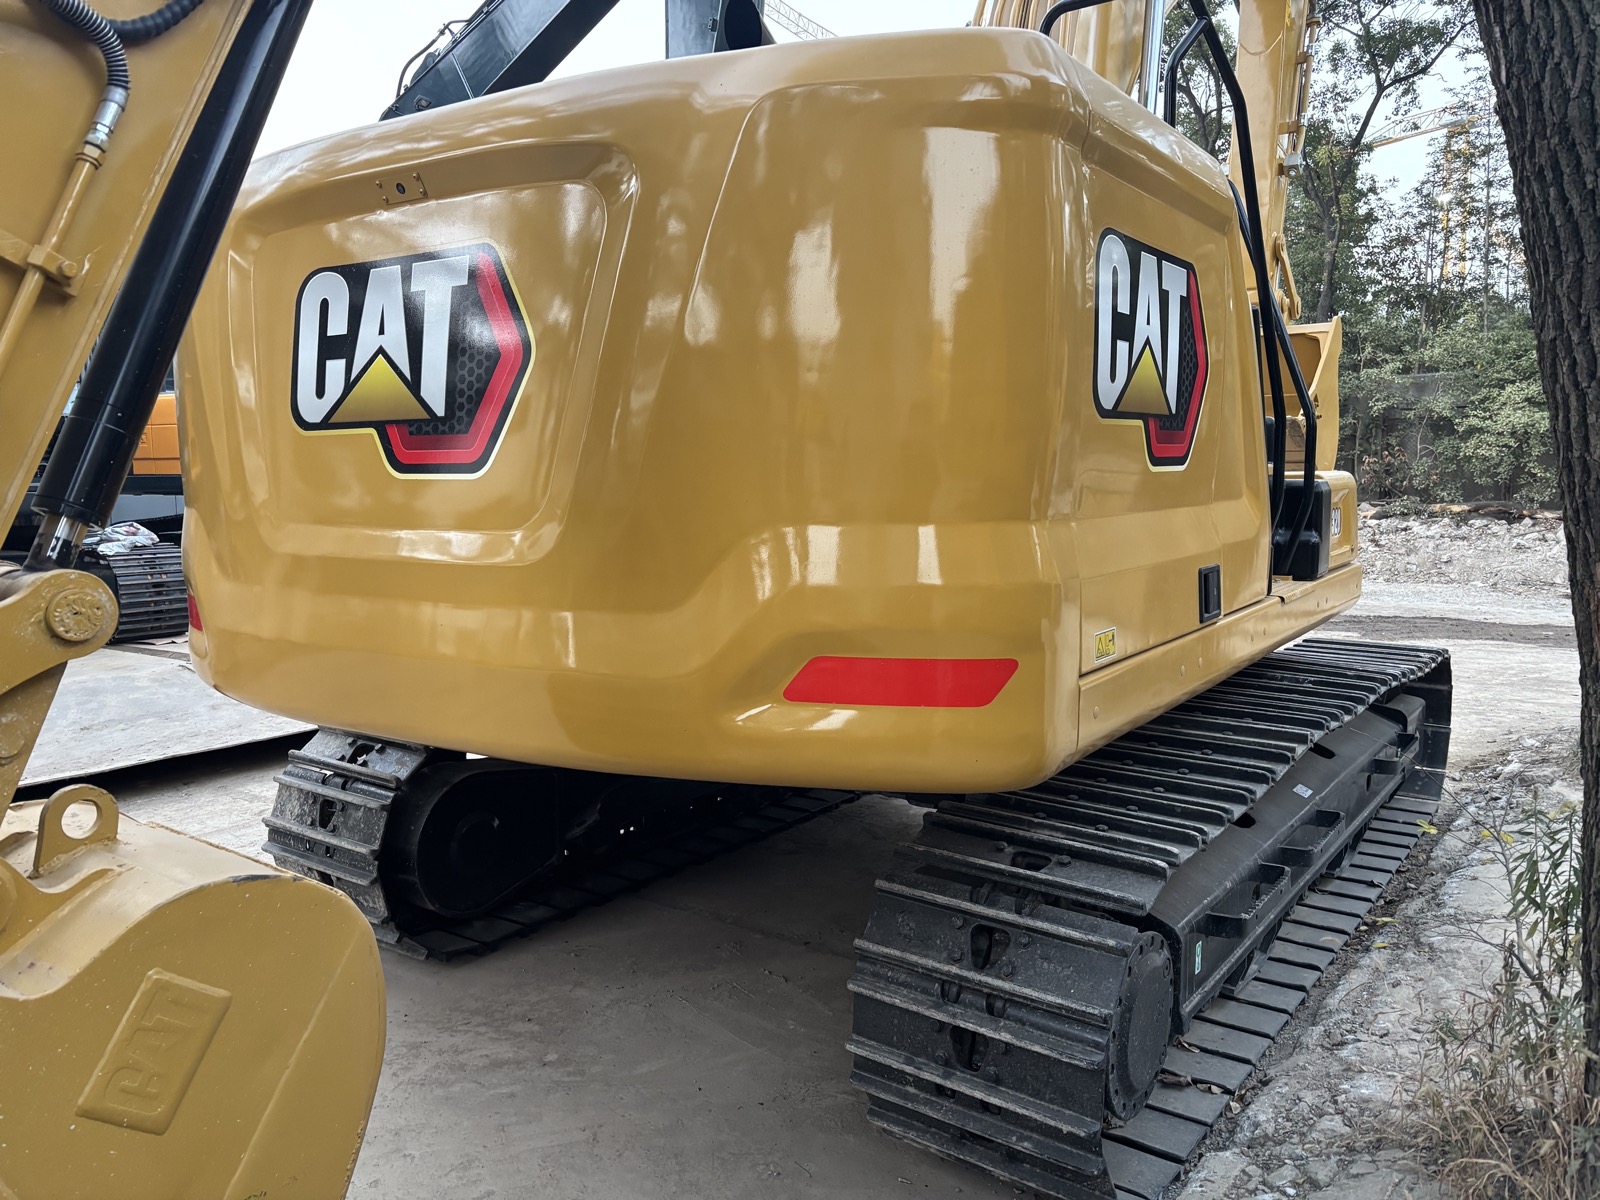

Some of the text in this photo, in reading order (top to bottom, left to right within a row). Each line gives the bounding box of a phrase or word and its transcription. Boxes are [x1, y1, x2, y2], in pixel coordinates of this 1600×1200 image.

[297, 255, 469, 423] CAT
[1097, 234, 1187, 415] CAT
[104, 984, 204, 1115] CAT
